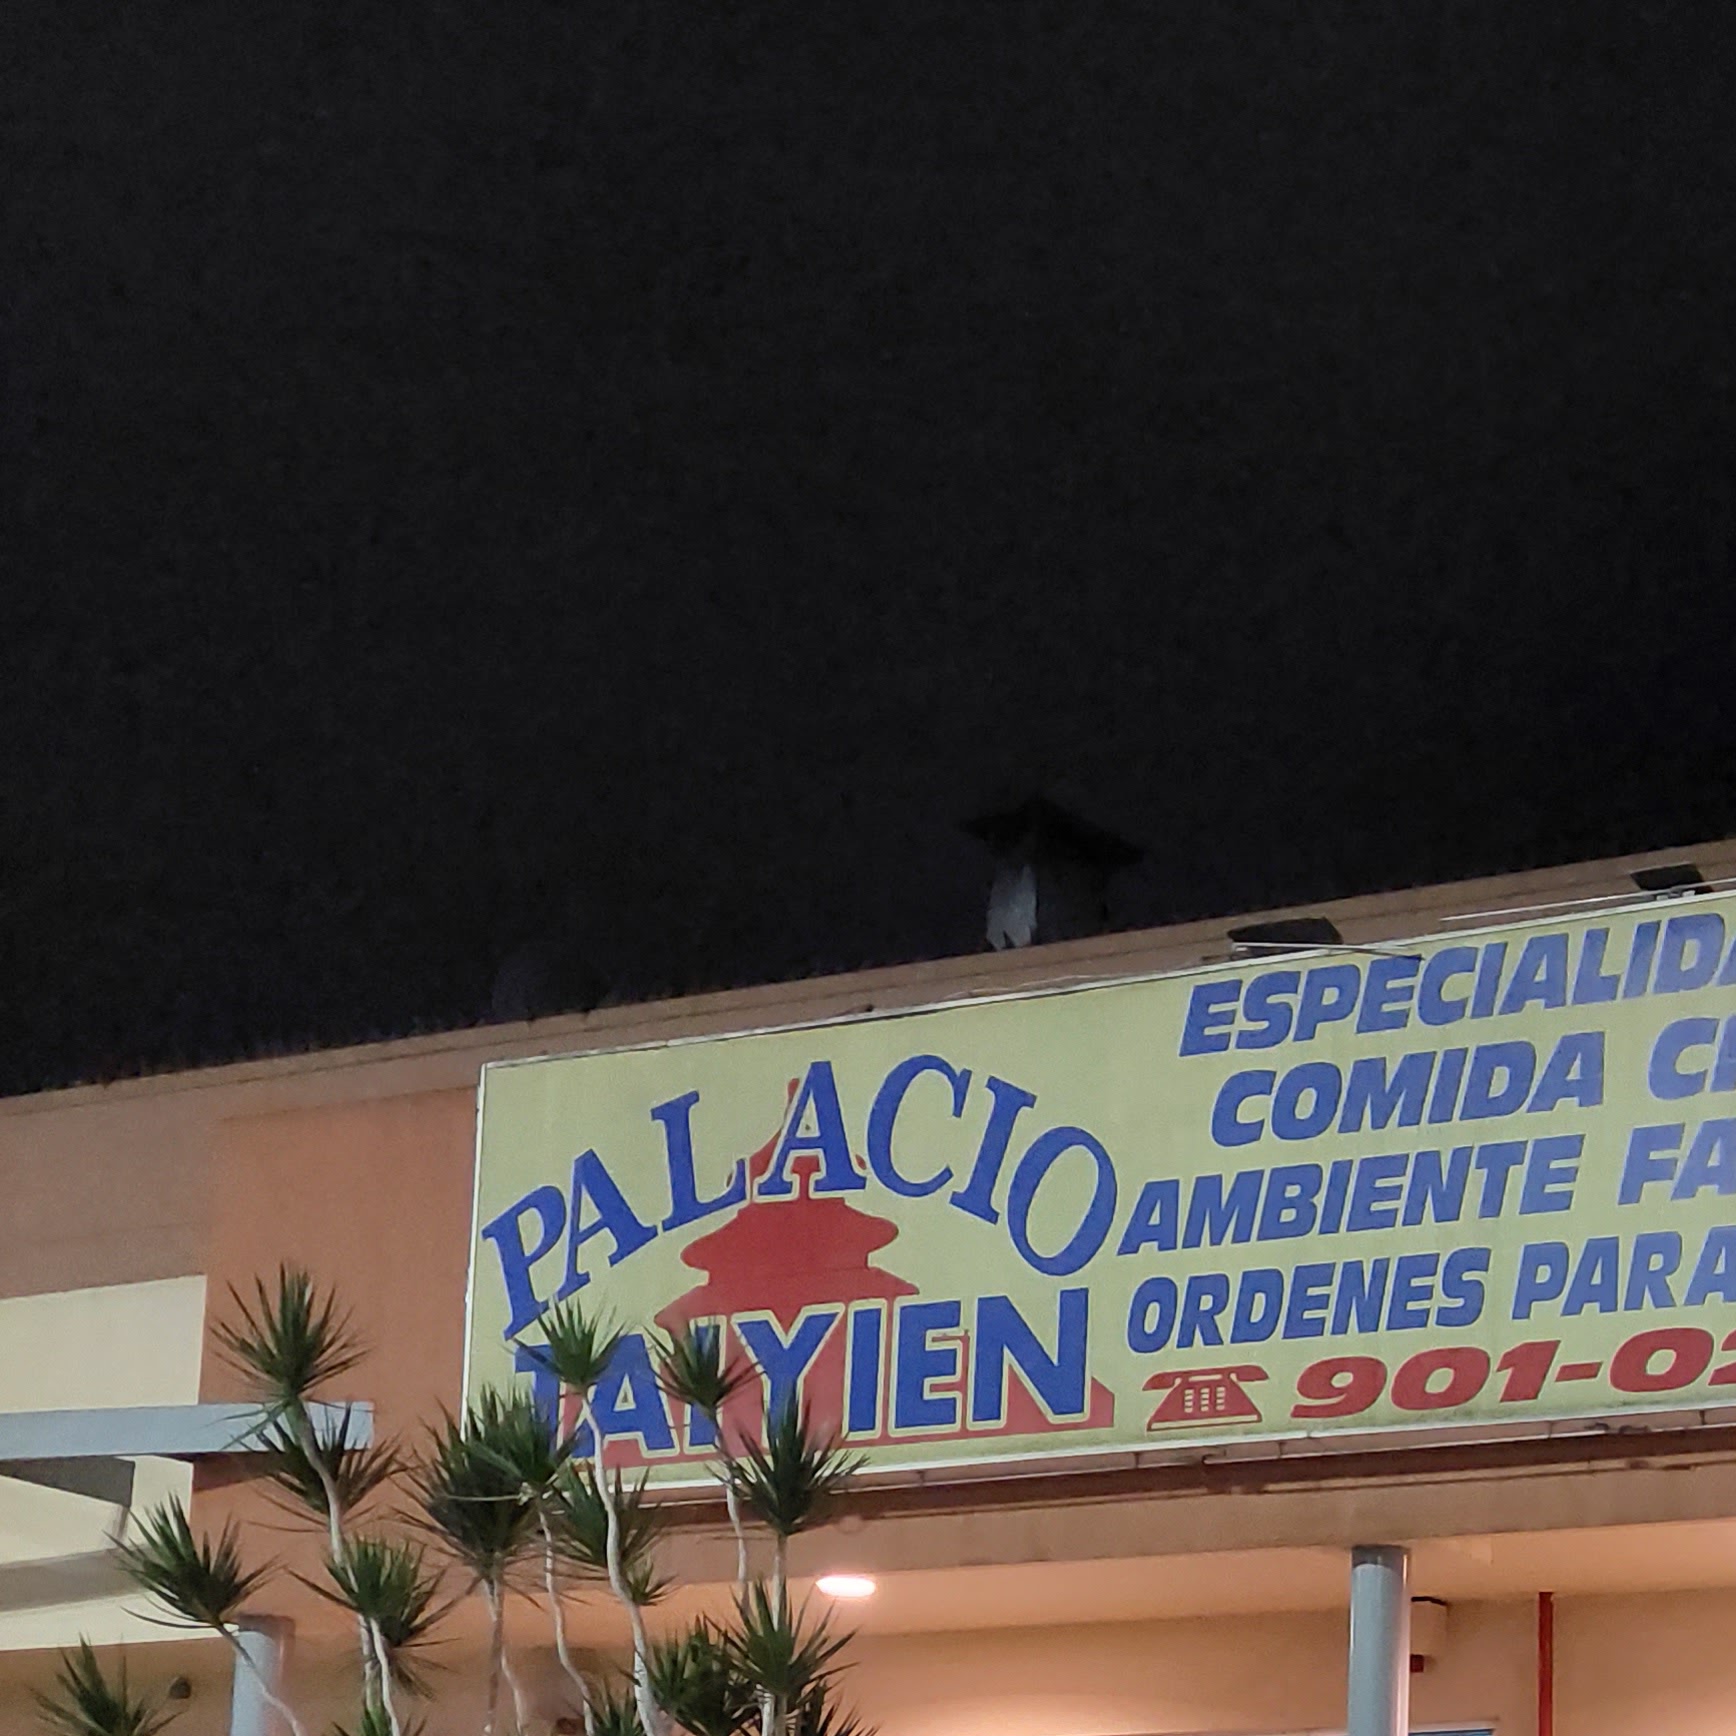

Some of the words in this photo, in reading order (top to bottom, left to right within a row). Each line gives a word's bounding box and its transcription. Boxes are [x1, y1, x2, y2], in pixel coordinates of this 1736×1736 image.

[1211, 1032, 1603, 1147] COMIDA
[482, 1055, 1117, 1340] PALACIO
[1118, 1134, 1584, 1256] AMBIENTE
[1126, 1247, 1490, 1354] ORDENES
[515, 1288, 1089, 1459] TAIYIEN
